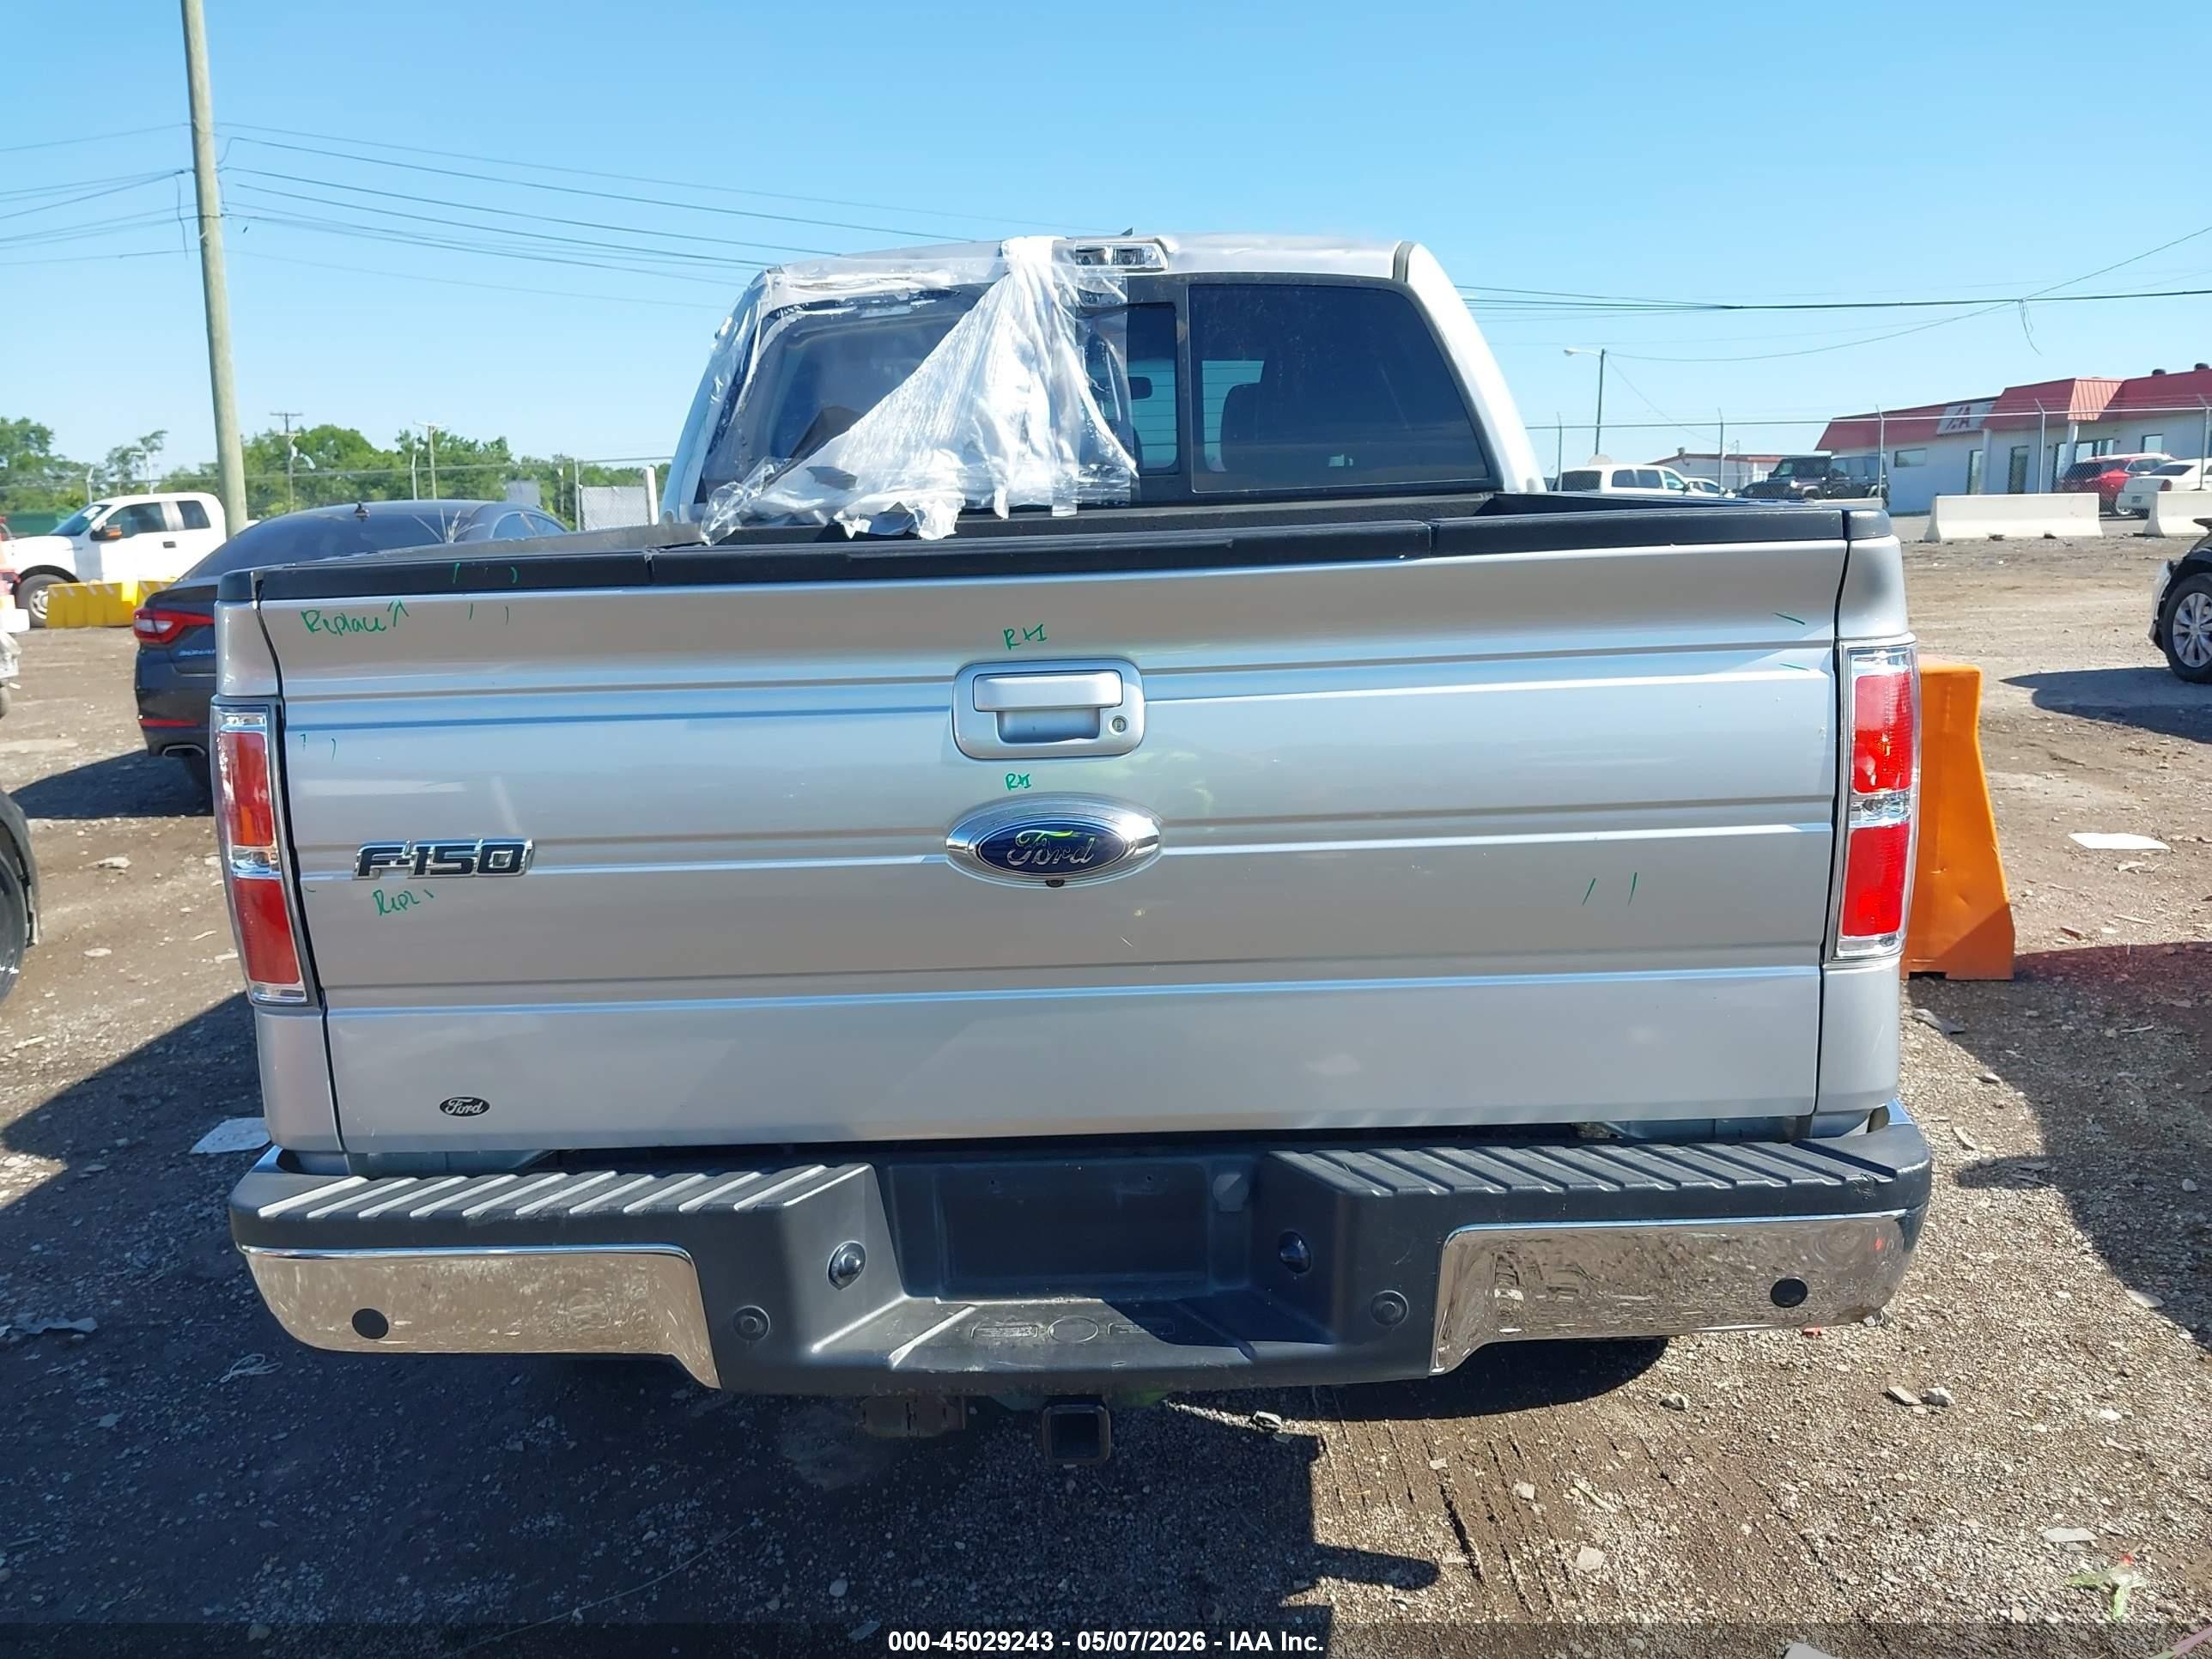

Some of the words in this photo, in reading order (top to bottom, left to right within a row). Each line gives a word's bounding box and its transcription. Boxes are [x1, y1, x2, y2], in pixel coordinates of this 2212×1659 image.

[301, 610, 387, 637] Replace
[352, 838, 536, 881] F-150
[1006, 829, 1097, 866] Ford
[445, 1098, 484, 1115] Ford
